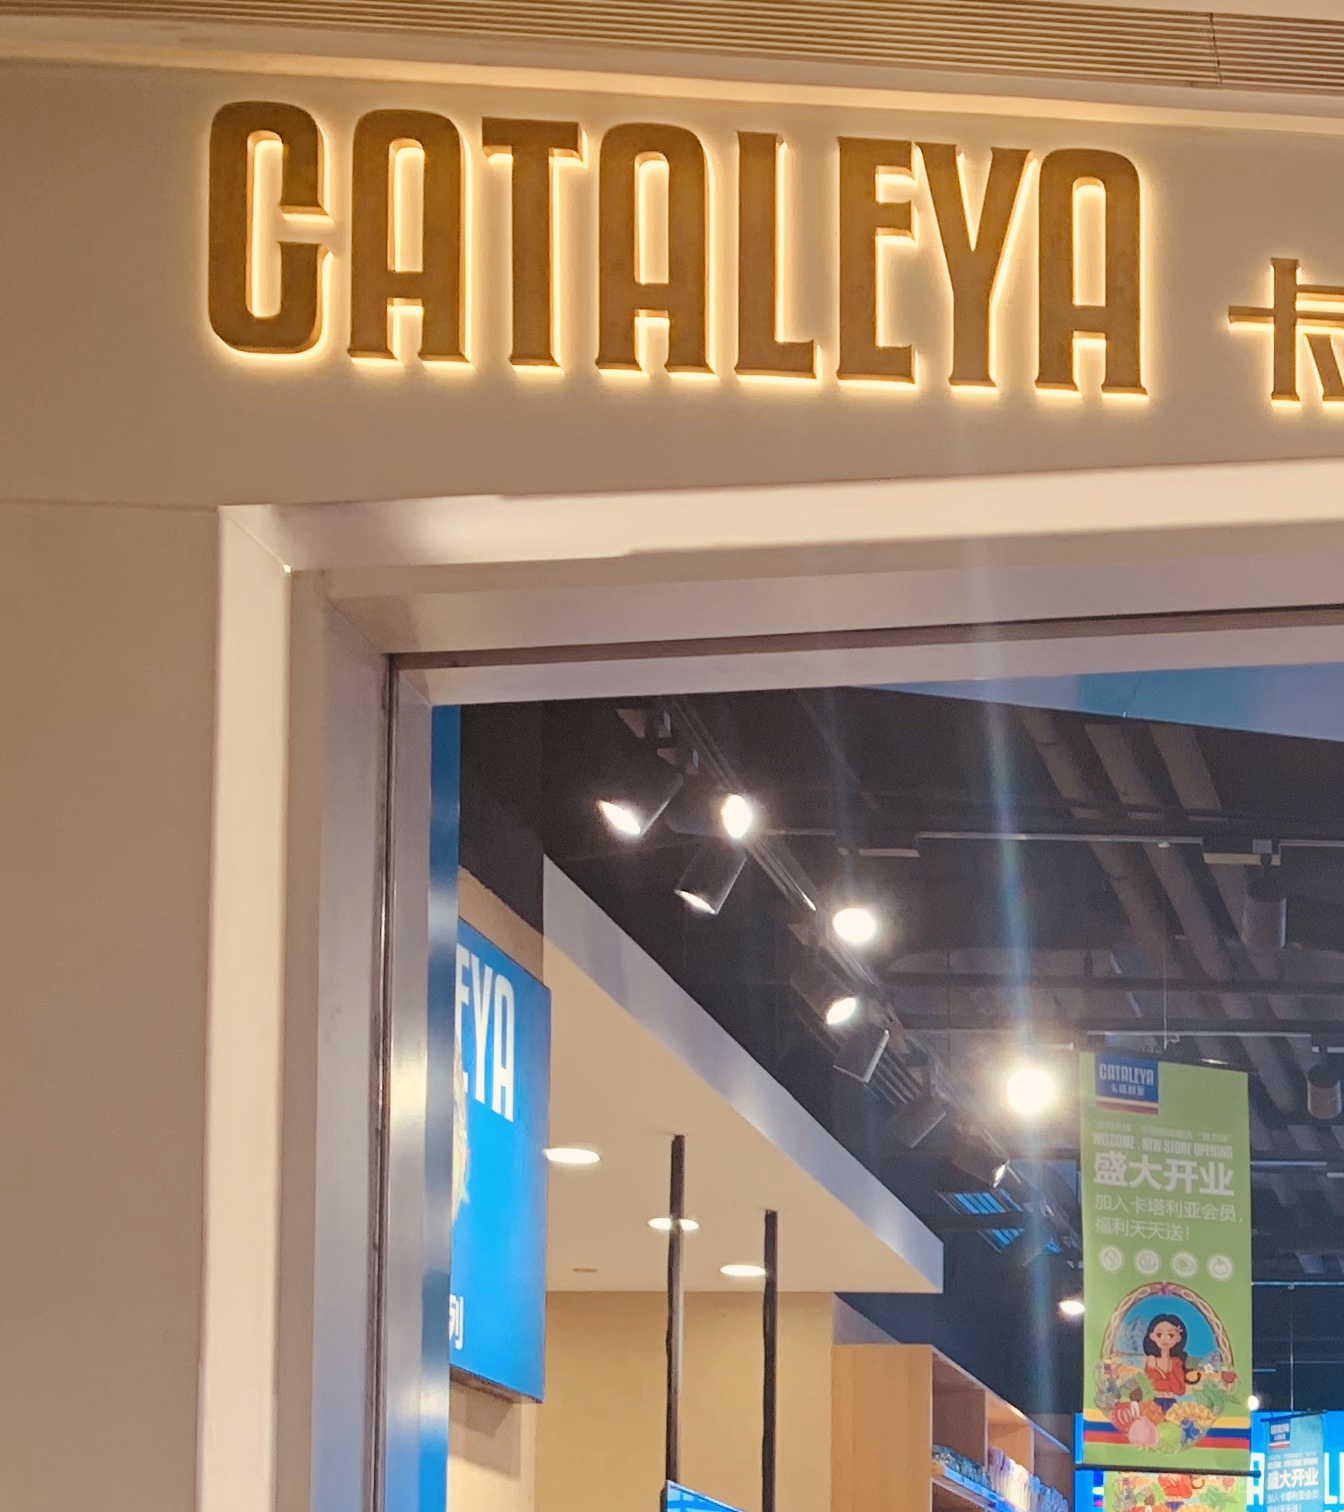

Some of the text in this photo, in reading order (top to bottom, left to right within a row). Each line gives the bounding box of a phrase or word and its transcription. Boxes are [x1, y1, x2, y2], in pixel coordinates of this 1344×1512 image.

[207, 100, 1150, 398] CATALEYA
[1099, 1063, 1154, 1087] CATALEYA
[1143, 1137, 1162, 1152] NEW
[1193, 1143, 1233, 1160] OPENING
[1093, 1151, 1235, 1197] 盛大开业
